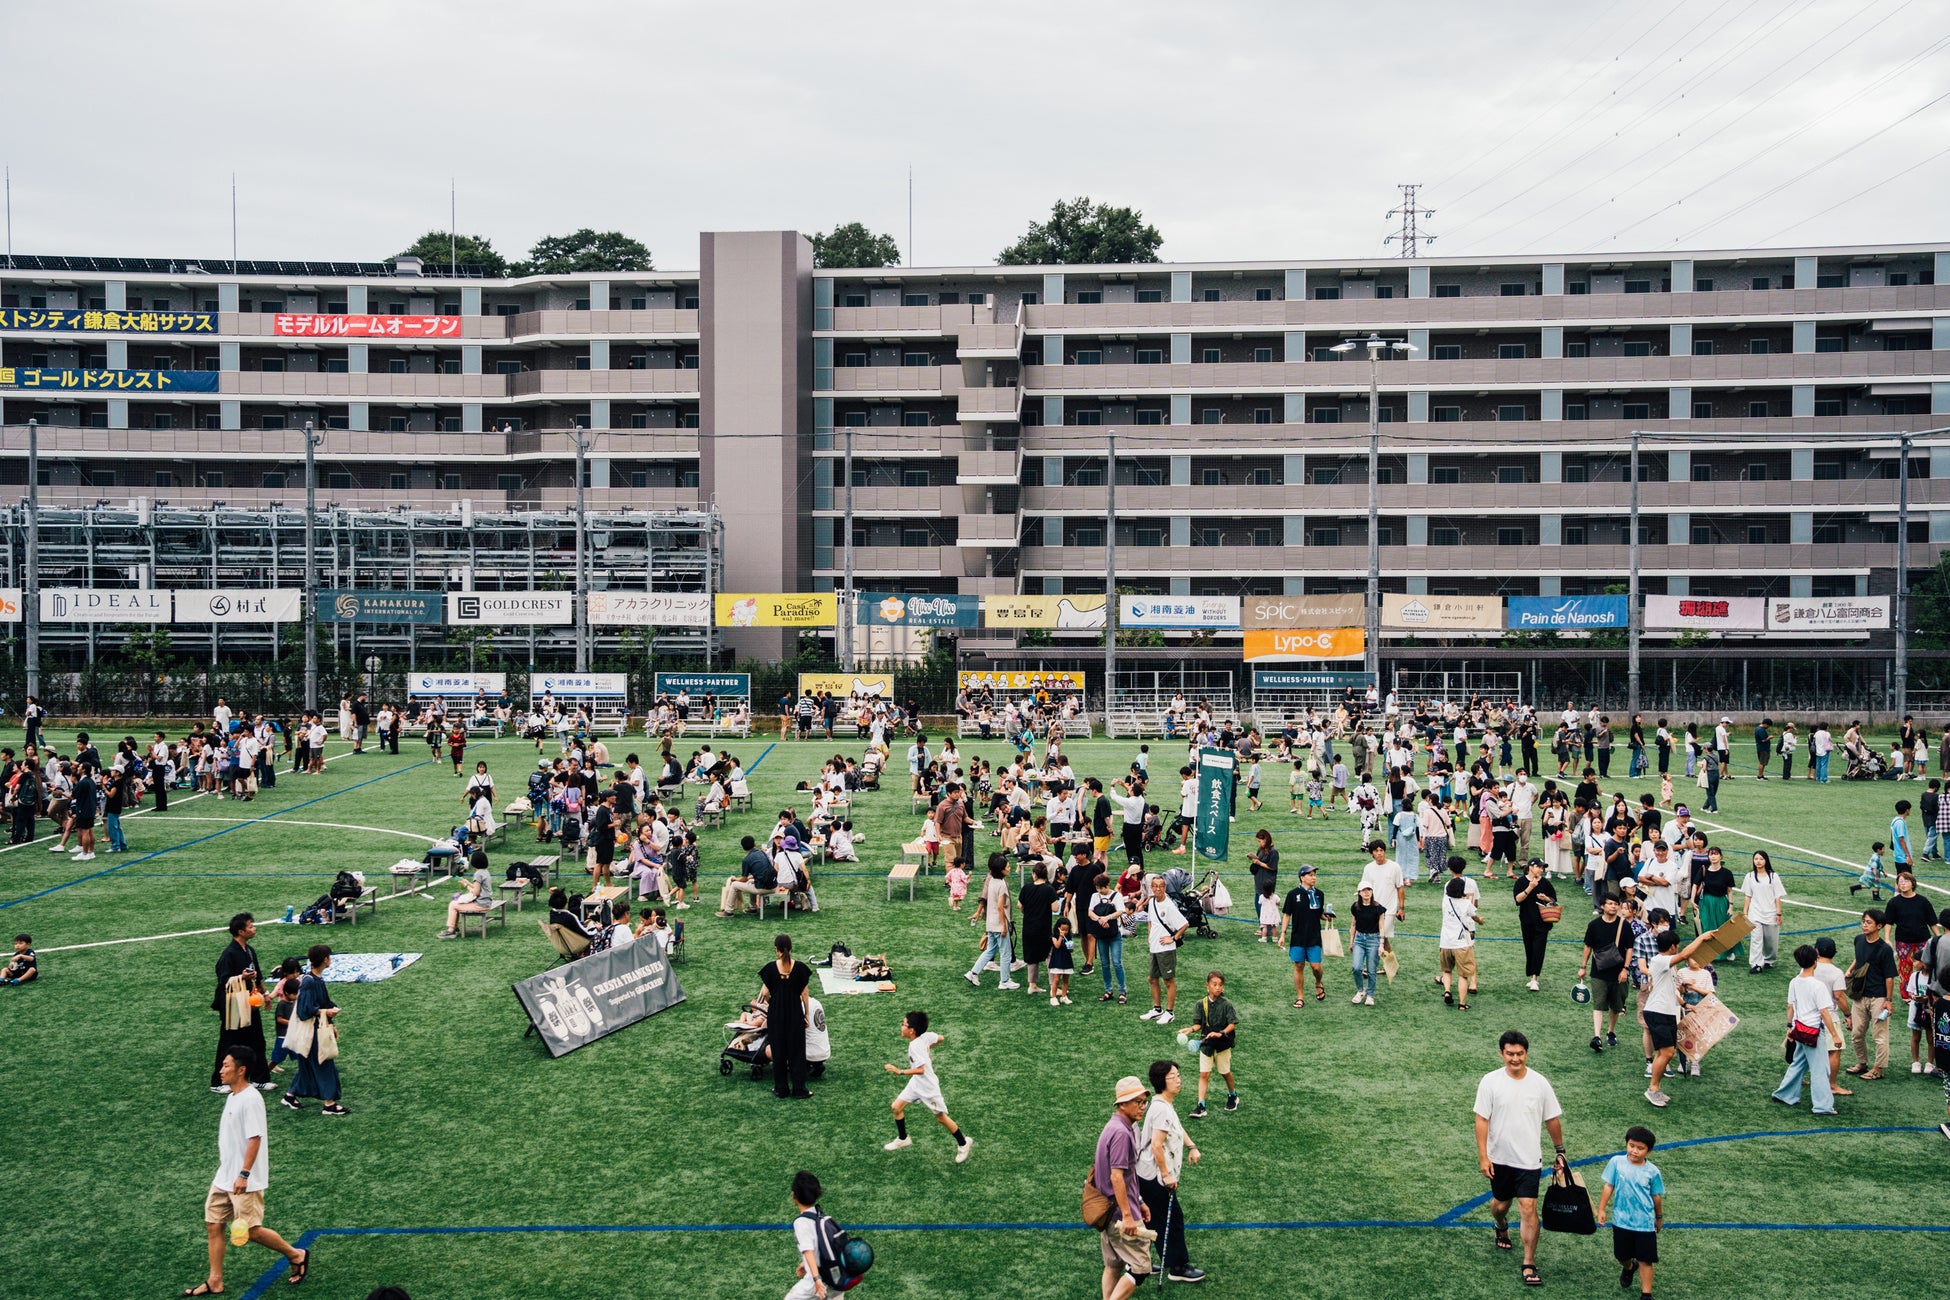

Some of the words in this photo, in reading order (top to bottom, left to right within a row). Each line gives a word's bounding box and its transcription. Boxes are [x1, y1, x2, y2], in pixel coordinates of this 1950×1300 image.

[278, 316, 458, 335] モデルルームオープン
[24, 369, 172, 389] ゴールドクレスト
[74, 594, 160, 607] IDEAL
[237, 597, 266, 613] 村式
[364, 599, 425, 608] KAMAKURA
[483, 600, 520, 610] GOLD
[522, 600, 562, 610] CREST
[614, 597, 710, 611] アカラクリニック
[773, 605, 820, 616] Paradiso
[1150, 605, 1195, 615] 湘南菱油
[1433, 603, 1484, 612] 鎌倉小川軒
[1793, 607, 1883, 619] 鎌倉ハム富岡商会
[1521, 612, 1549, 624] Pain
[1550, 613, 1566, 624] de
[1567, 611, 1615, 624] Nanosh
[1274, 633, 1333, 652] Lypo-C
[665, 678, 739, 686] WELLNESS-PARTNER
[1207, 778, 1222, 835] 飲食スペース
[593, 977, 624, 996] CRESTA
